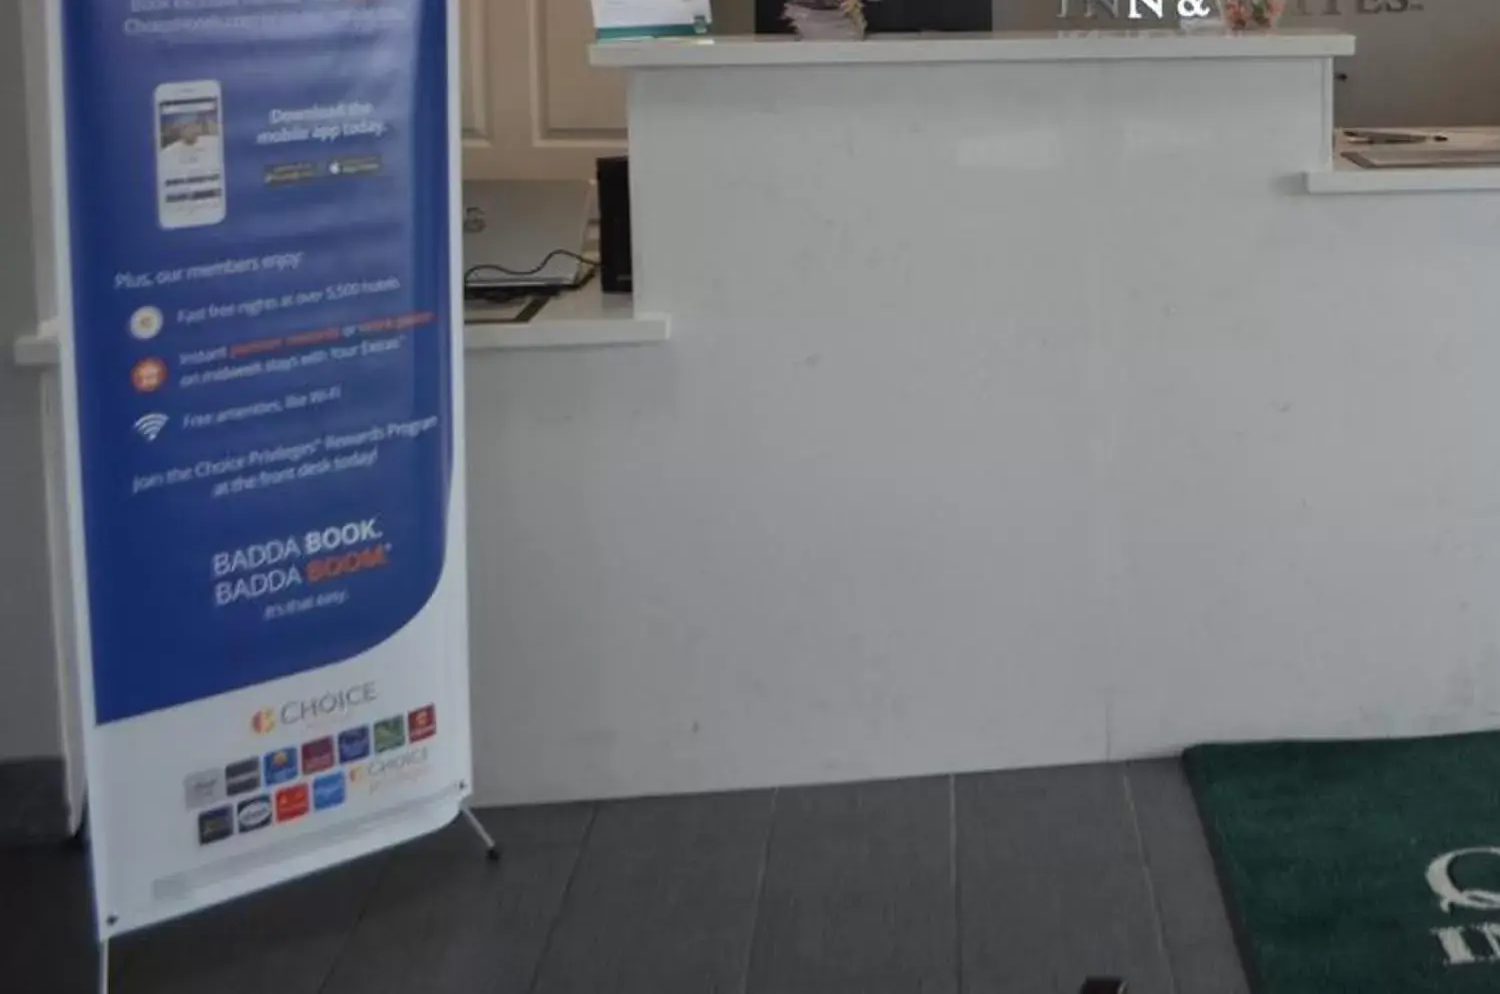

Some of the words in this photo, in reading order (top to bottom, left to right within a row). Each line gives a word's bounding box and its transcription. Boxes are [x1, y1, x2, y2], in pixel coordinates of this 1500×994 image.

[256, 127, 309, 144] mobile
[312, 125, 340, 144] app
[156, 268, 183, 285] our
[186, 257, 259, 280] members
[296, 290, 323, 305] over
[179, 372, 199, 388] on
[202, 361, 262, 383] midweek
[265, 355, 299, 373] stays
[301, 349, 329, 367] with
[183, 412, 215, 430] Free
[132, 473, 165, 495] Join
[166, 466, 193, 484] the
[194, 456, 246, 478] Choice
[324, 426, 386, 450] Rewards
[211, 480, 229, 497] at
[230, 475, 257, 493] the
[259, 466, 296, 486] front
[297, 457, 332, 478] desk
[212, 534, 301, 576] BADDA
[304, 517, 383, 555] BOOK.
[214, 563, 303, 606] BADDA
[279, 680, 380, 726] CHOICE
